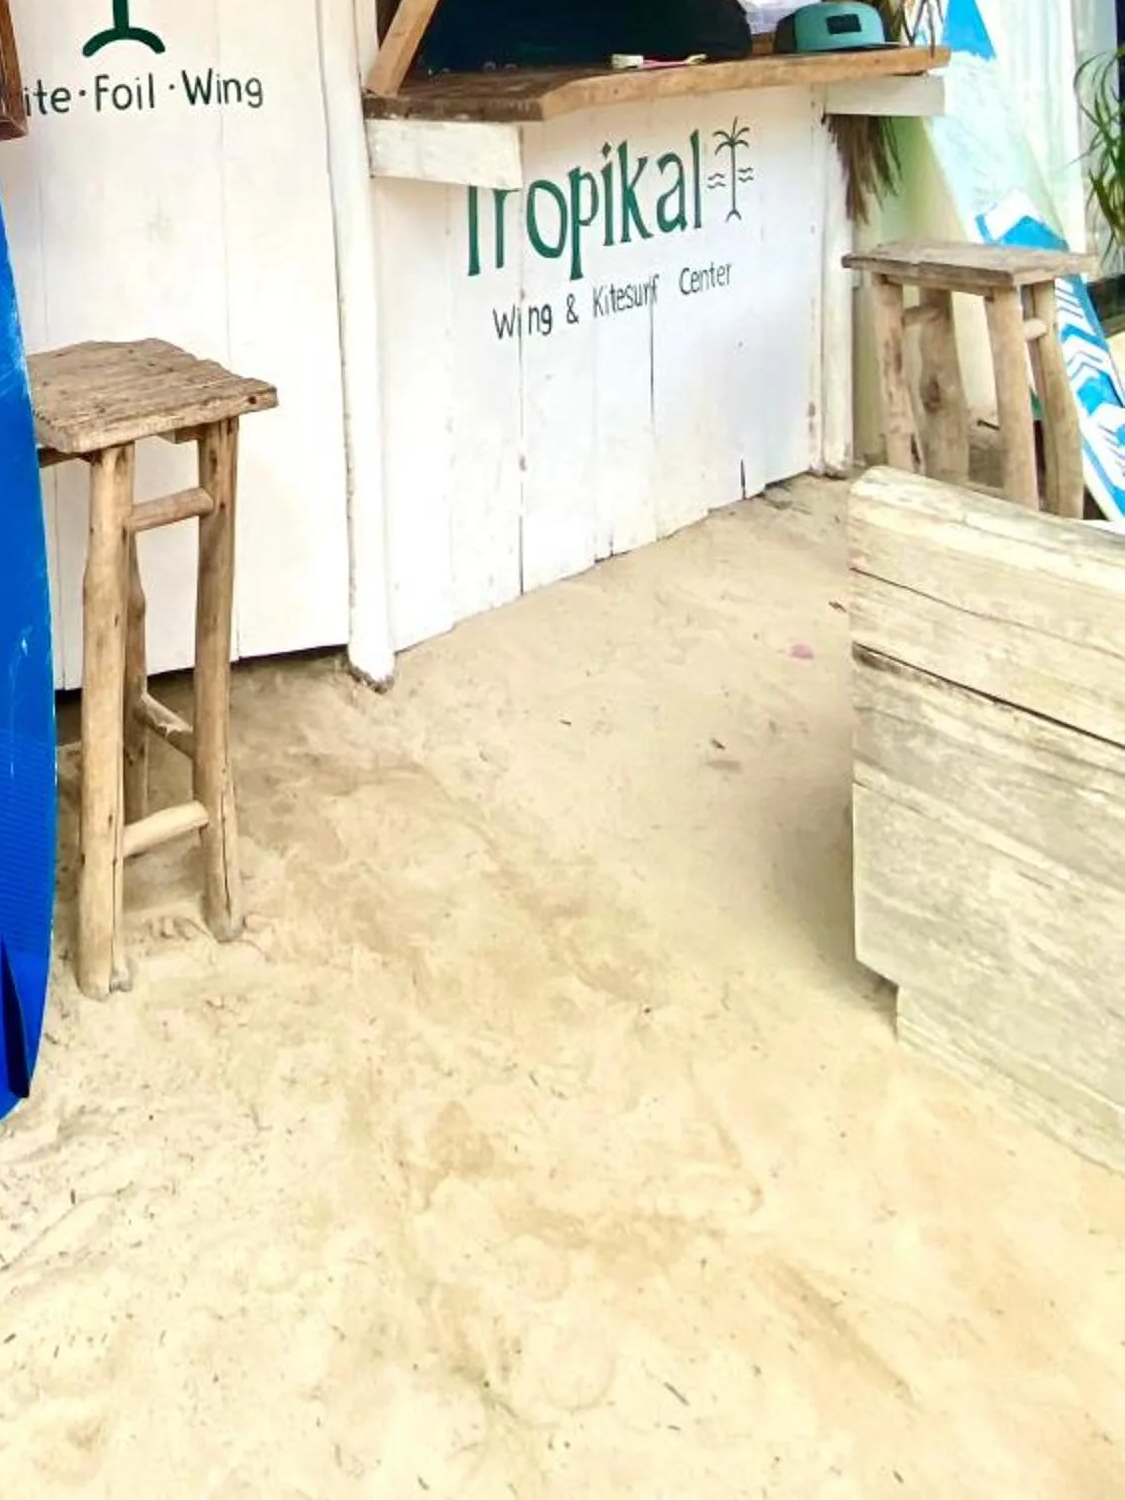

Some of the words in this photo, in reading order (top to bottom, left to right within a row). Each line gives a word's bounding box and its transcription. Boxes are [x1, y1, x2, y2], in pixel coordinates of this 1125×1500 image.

[23, 78, 72, 116] ite
[94, 72, 155, 112] Foil
[181, 67, 263, 109] Wing
[493, 304, 553, 340] Wing
[565, 293, 579, 325] &
[592, 273, 659, 319] Kitesurf
[679, 261, 733, 296] Center
